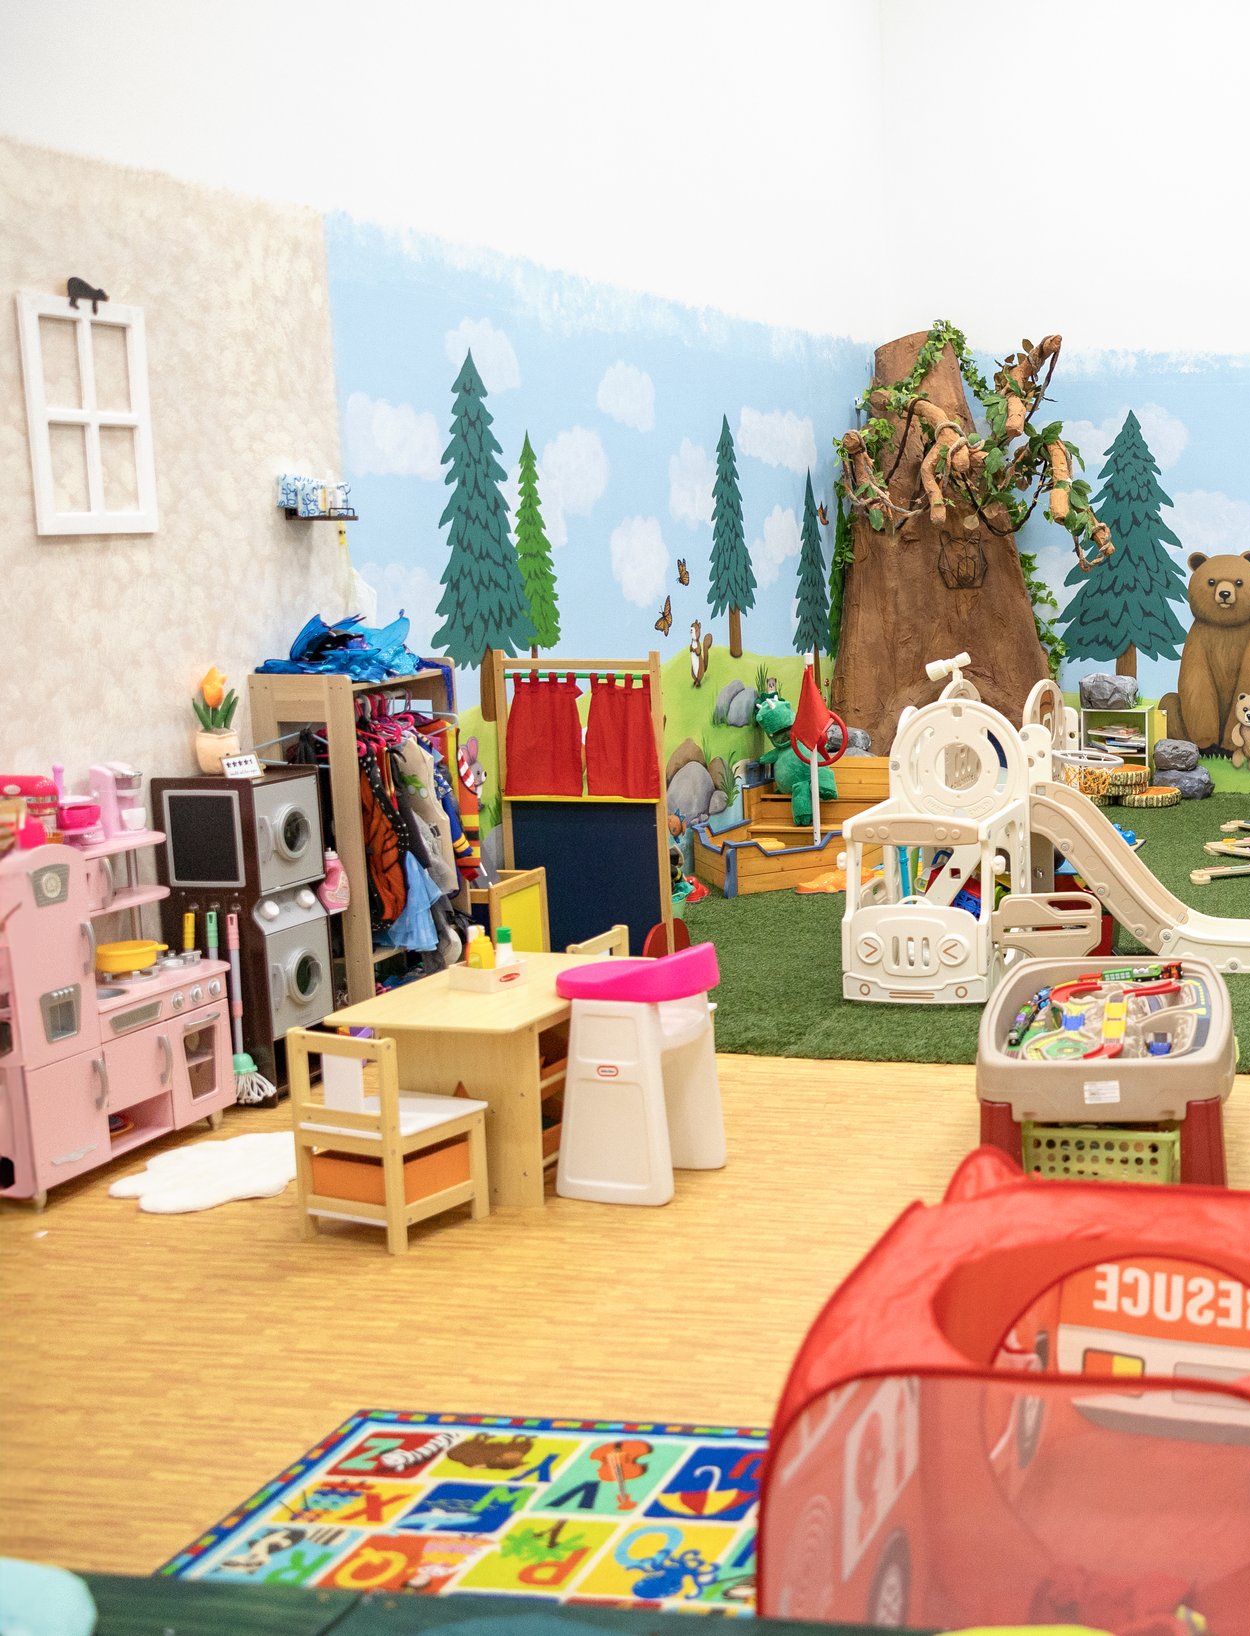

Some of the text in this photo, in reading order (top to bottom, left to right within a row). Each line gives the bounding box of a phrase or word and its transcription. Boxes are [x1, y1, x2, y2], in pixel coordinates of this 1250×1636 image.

[337, 1493, 414, 1522] X
[334, 1547, 408, 1588] Q
[517, 1547, 592, 1586] P
